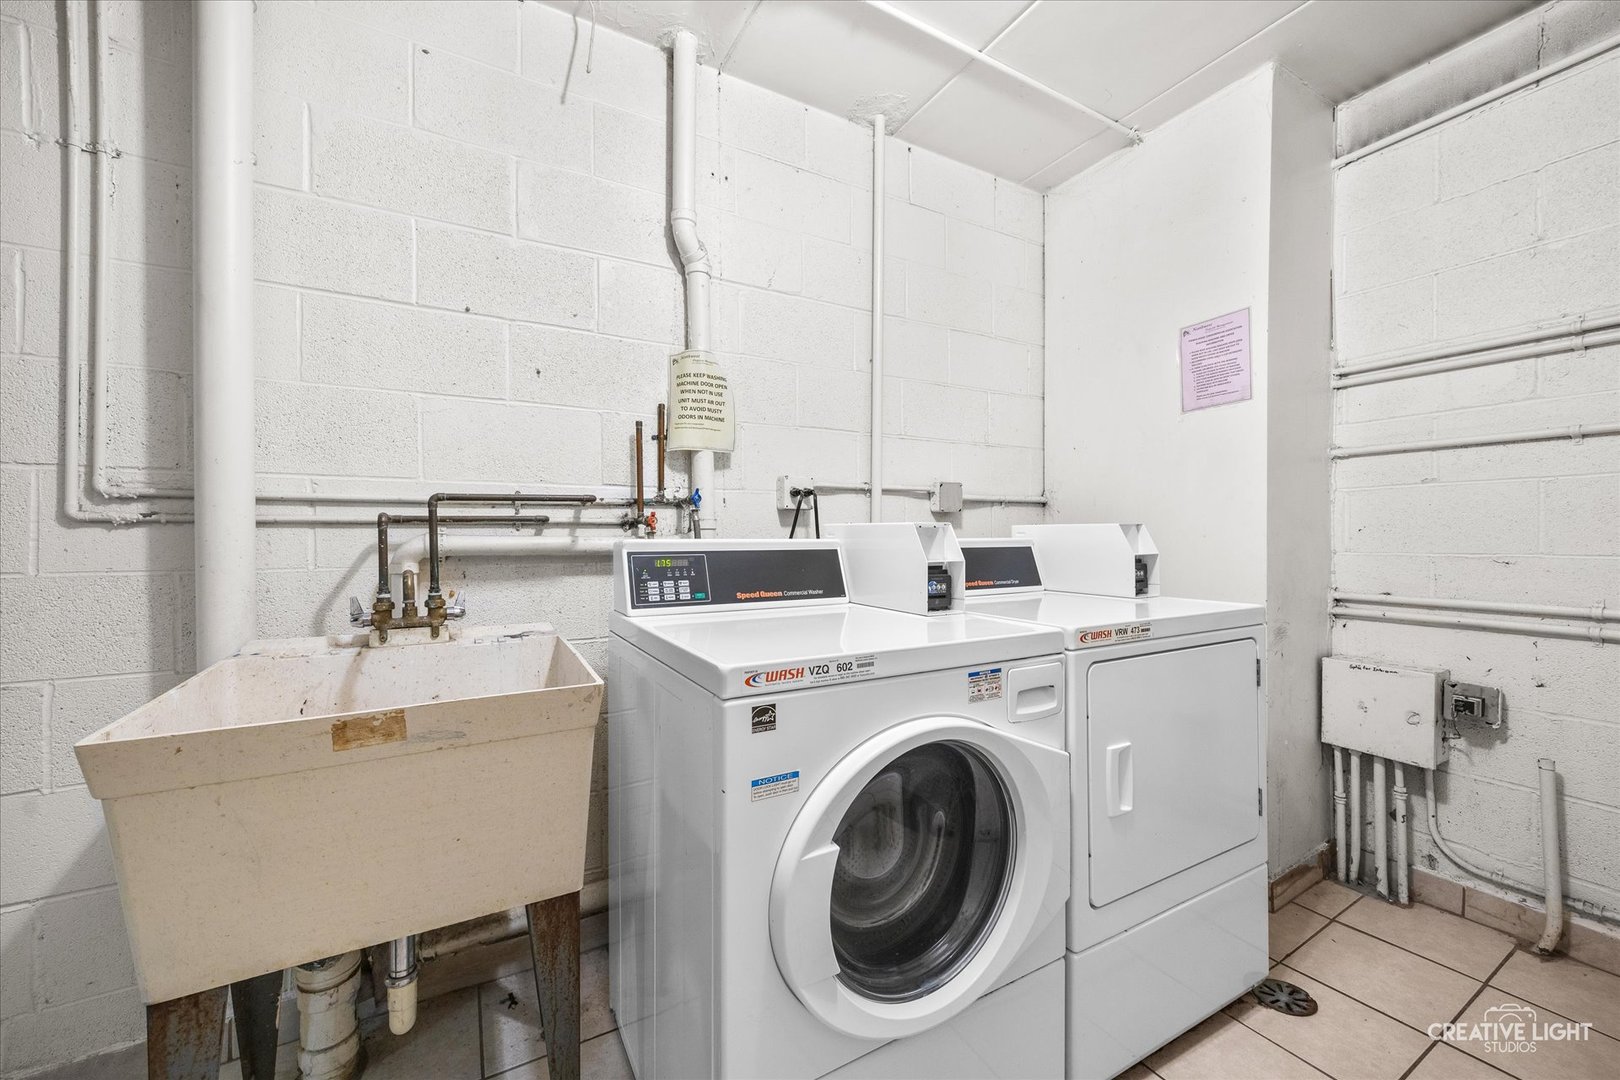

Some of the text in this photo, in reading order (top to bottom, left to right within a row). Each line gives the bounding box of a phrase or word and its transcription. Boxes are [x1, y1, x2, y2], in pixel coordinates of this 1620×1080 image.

[706, 374, 727, 382] WASHING
[736, 590, 760, 600] Speed
[760, 589, 783, 598] Queen
[783, 589, 808, 597] Commercial
[1090, 629, 1112, 640] WASH
[1114, 627, 1129, 636] VRW
[1130, 626, 1141, 634] 473
[765, 667, 804, 683] WASH
[808, 664, 830, 676] VZQ
[836, 661, 853, 673] 602
[758, 774, 792, 785] NOTICE
